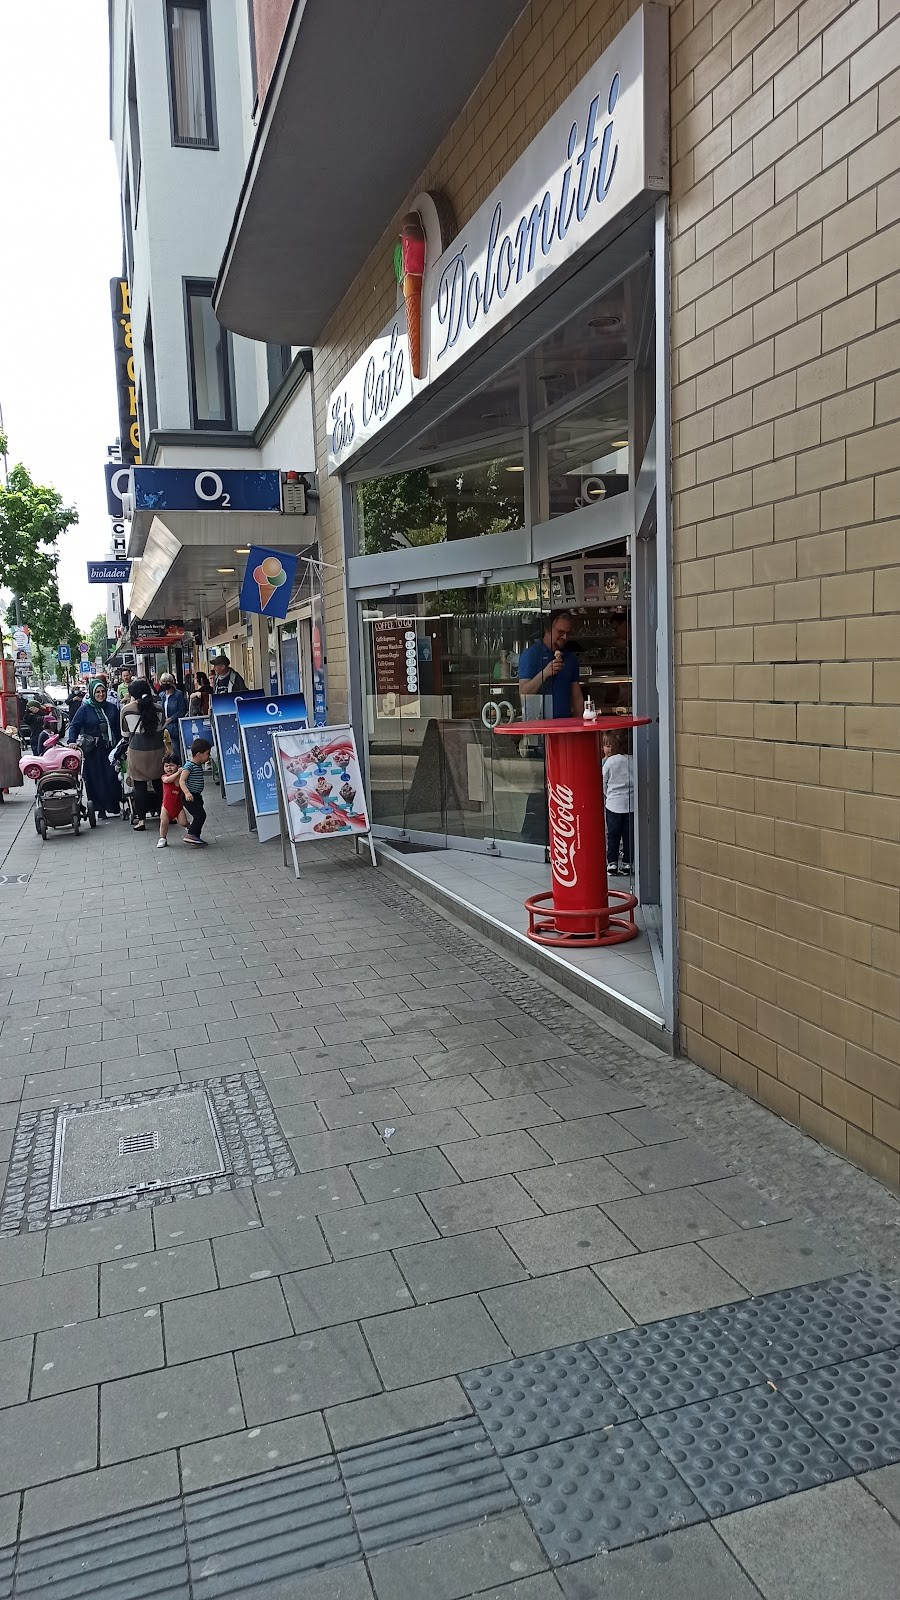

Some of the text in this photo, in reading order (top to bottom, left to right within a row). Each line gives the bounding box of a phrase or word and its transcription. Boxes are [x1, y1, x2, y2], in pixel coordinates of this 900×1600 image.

[436, 71, 620, 362] Dolomiti
[332, 321, 404, 455] Eis Cafe
[194, 471, 231, 507] O2
[90, 567, 126, 578] bioladen
[375, 619, 413, 630] COFFEE TO GO
[61, 647, 68, 659] P
[82, 662, 88, 671] P
[266, 703, 282, 717] O2
[547, 777, 577, 887] Coca-Cola
